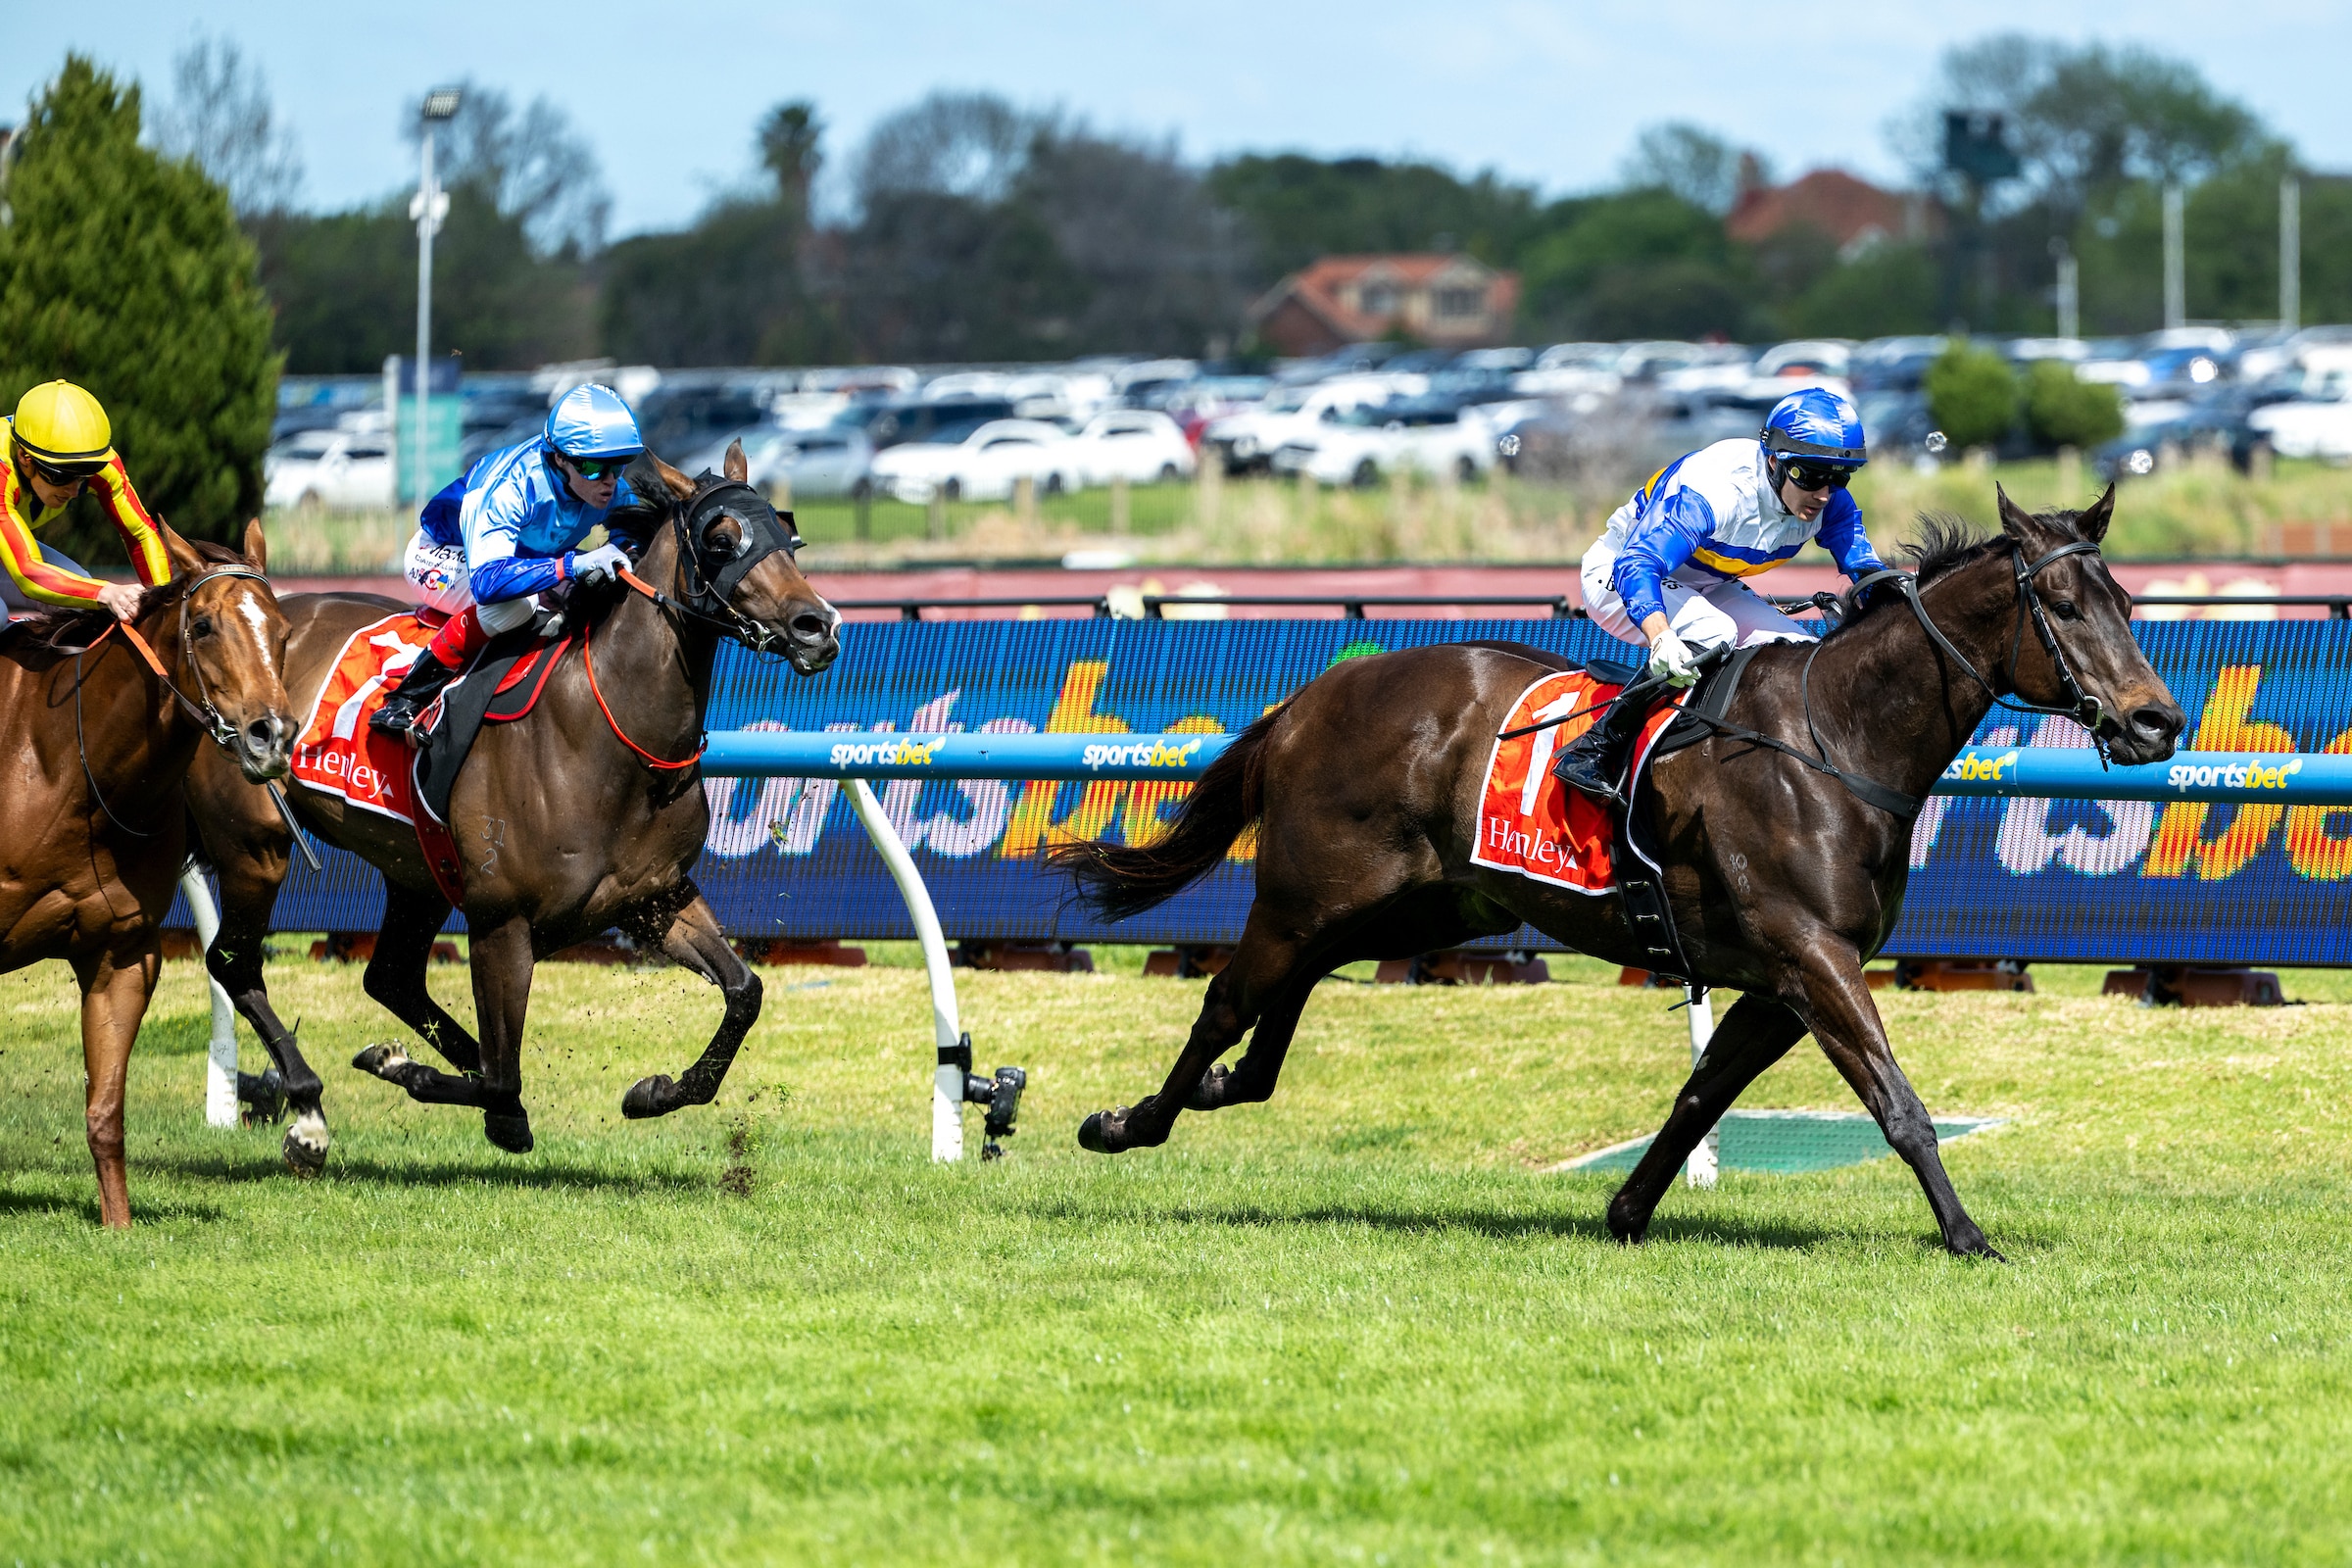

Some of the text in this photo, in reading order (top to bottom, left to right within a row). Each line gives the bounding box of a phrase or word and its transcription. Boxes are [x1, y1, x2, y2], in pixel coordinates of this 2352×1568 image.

[297, 742, 387, 800] Henley
[829, 737, 936, 770] sportsbet
[1082, 739, 1192, 771] sportsbet
[1520, 690, 1582, 817] 1
[2167, 760, 2289, 793] sportsbet
[1488, 816, 1573, 873] Henley
